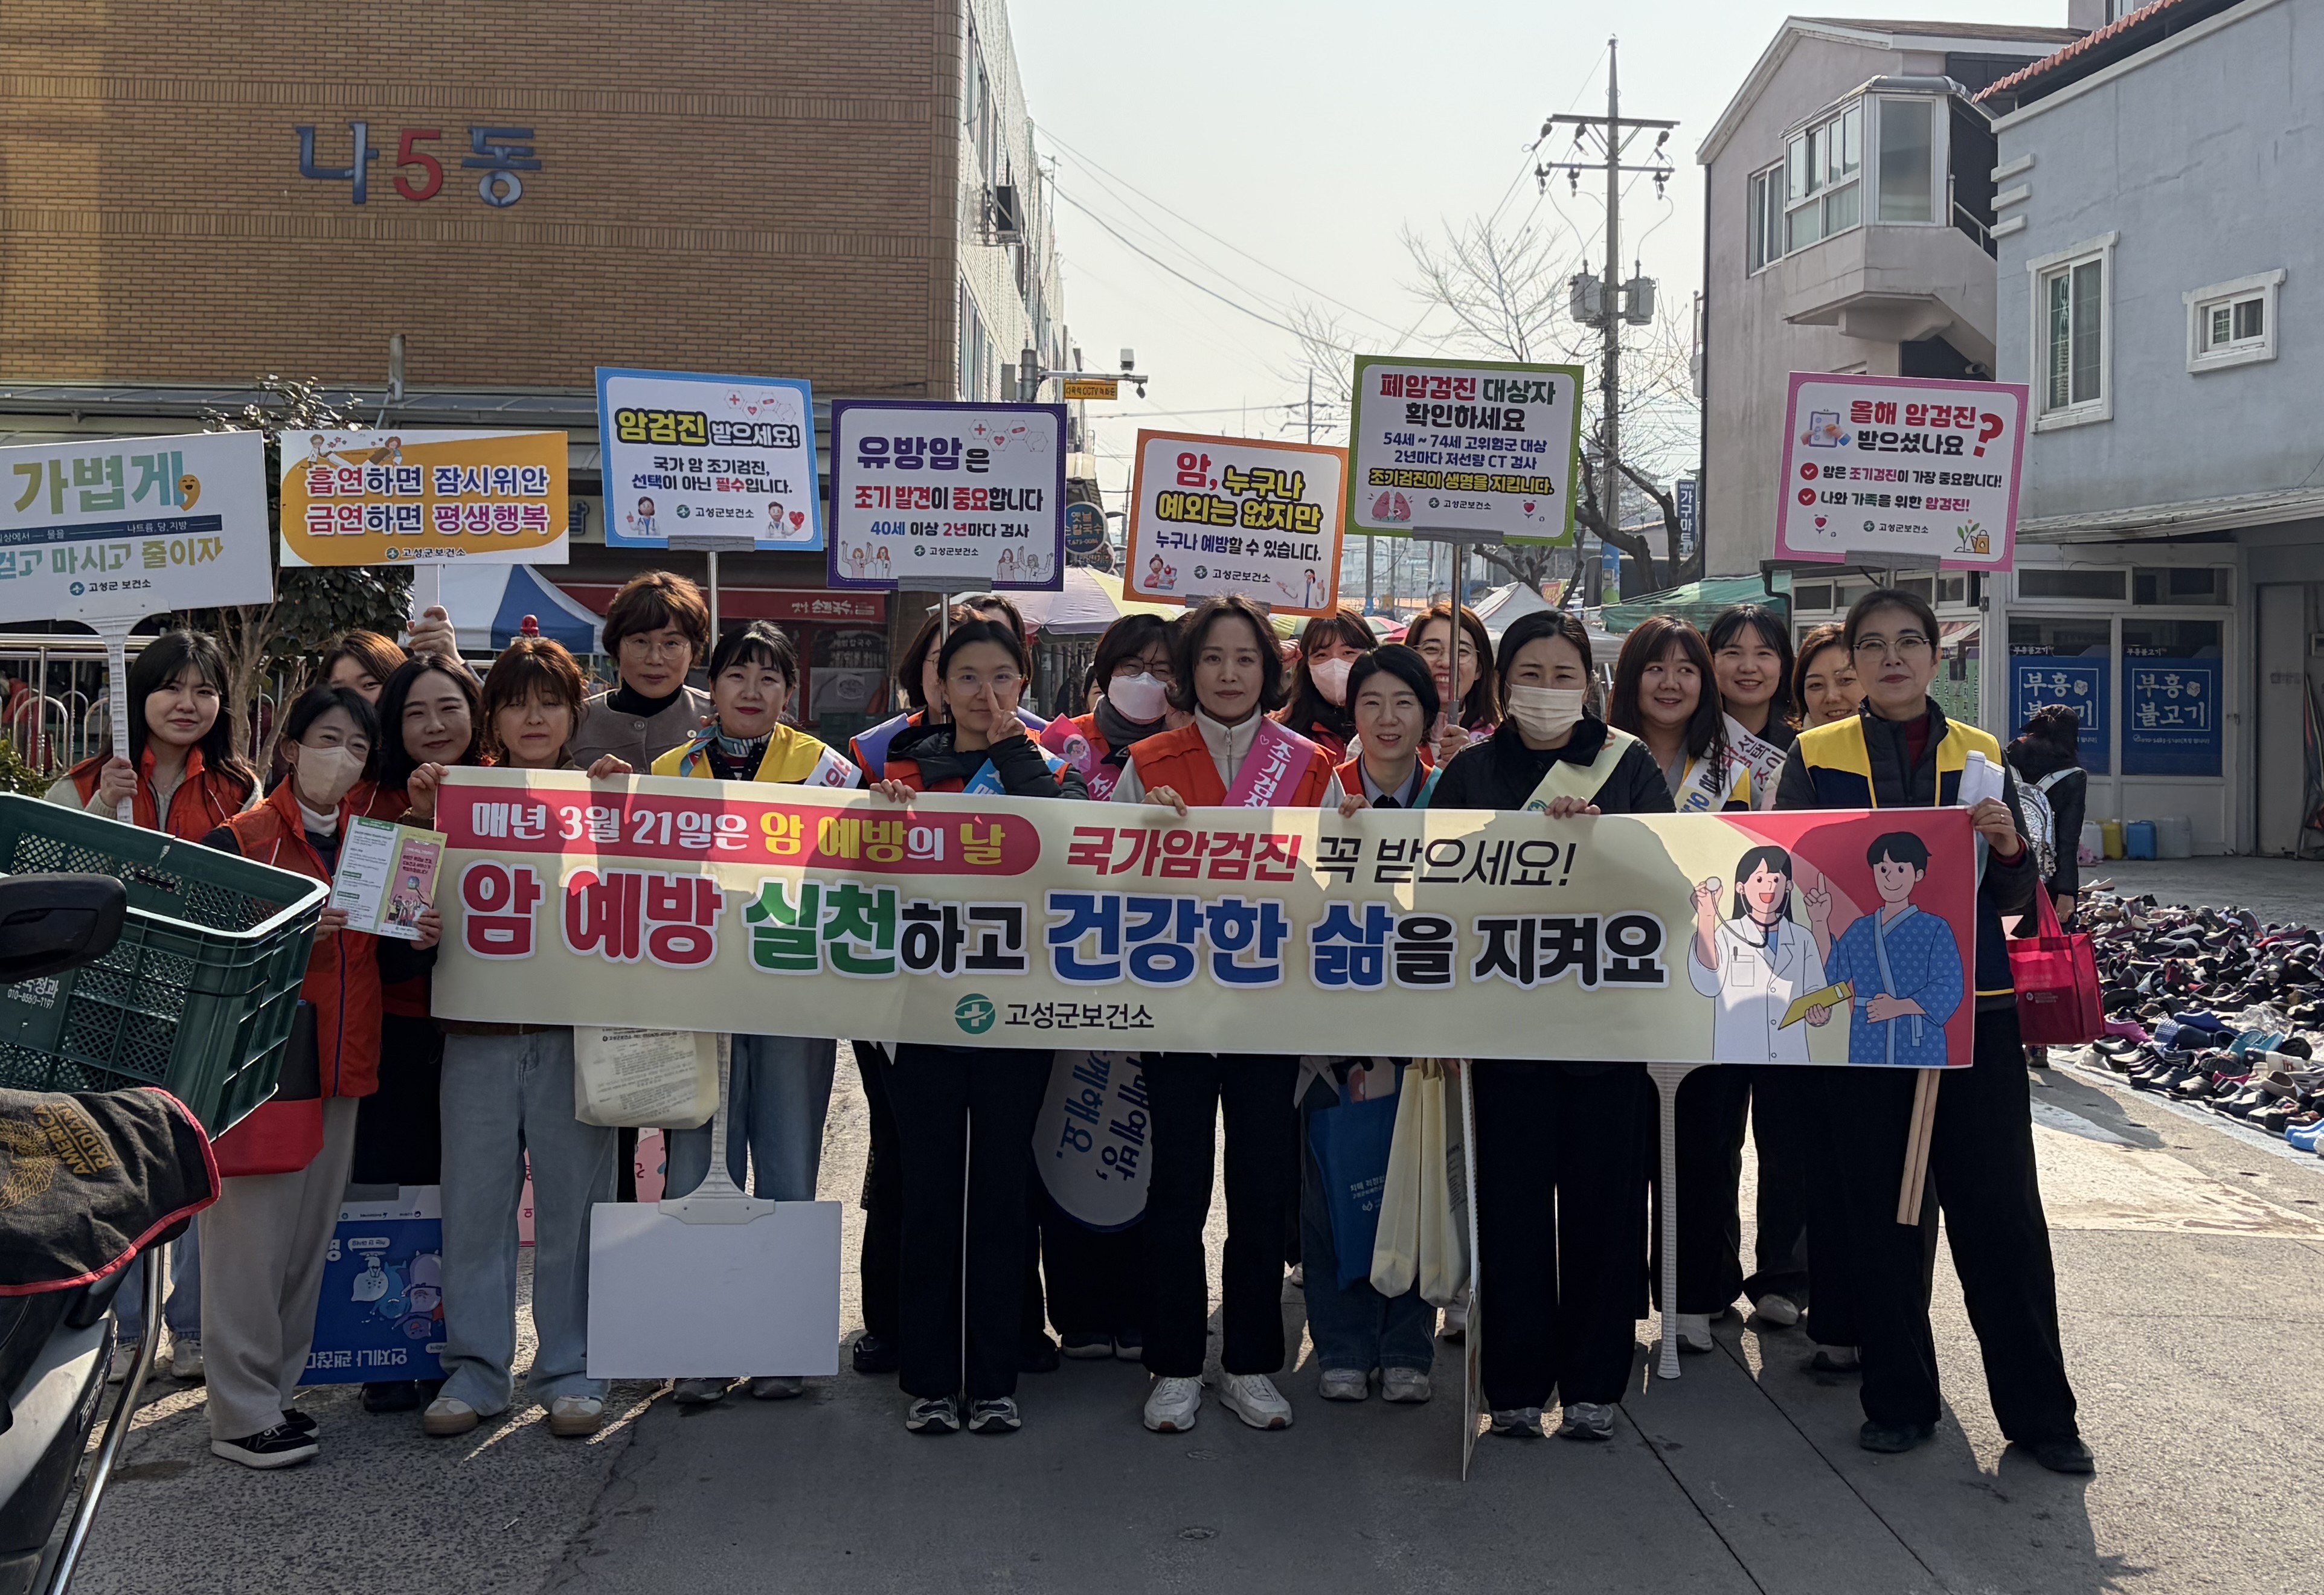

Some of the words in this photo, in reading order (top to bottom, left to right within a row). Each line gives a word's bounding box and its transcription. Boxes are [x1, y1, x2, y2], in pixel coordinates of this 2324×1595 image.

[1380, 373, 1475, 401] 폐암검진
[1482, 379, 1556, 405] 대상자
[1405, 402, 1526, 432] 확인하세요
[1850, 400, 1897, 425] 올해
[1905, 403, 1977, 429] 암검진
[617, 409, 708, 445] 암검진
[711, 422, 800, 448] 받으세요!
[857, 436, 990, 473] 유방암은
[1383, 432, 1414, 447] 54세
[1430, 435, 1461, 449] 74세
[1465, 436, 1517, 452] 고위험군
[1521, 439, 1547, 453] 대상
[653, 456, 684, 472] 국가
[689, 458, 704, 473] 암
[707, 458, 771, 477] 조기검진,
[1394, 450, 1443, 465] 2년마다
[1445, 452, 1485, 467] 저선량
[1488, 455, 1507, 469] CT
[1510, 455, 1537, 470] 검사
[307, 466, 423, 495] 흡연하면
[434, 466, 548, 495] 잠시위안
[632, 473, 678, 490] 선택이
[682, 477, 712, 492] 아닌
[716, 477, 793, 494] 필수입니다.
[1176, 452, 1219, 491] 암,
[1224, 466, 1304, 500] 누구나
[1369, 467, 1442, 489] 조기검진이
[1445, 471, 1488, 492] 생명을
[1490, 473, 1555, 496] 지킵니다.
[1823, 466, 1846, 480] 암은
[1849, 466, 1909, 483] 조기검진이
[1913, 470, 1936, 484] 가장
[1939, 472, 2003, 488] 중요합니다!
[855, 485, 891, 509] 조기
[895, 486, 948, 510] 발견이
[953, 487, 1044, 512] 중요합니다
[1443, 499, 1492, 510] 고성군보건소
[1820, 492, 1848, 506] 나와
[1851, 492, 1892, 509] 가족을
[1895, 495, 1922, 510] 위한
[1925, 496, 1970, 512] 암검진!
[307, 504, 423, 534] 금연하면
[435, 504, 549, 534] 평생행복
[695, 507, 755, 519] 고성군보건소
[1158, 492, 1237, 525] 예외는
[1242, 500, 1323, 533] 없지만
[870, 521, 905, 536] 40세
[910, 522, 939, 537] 이상
[943, 522, 997, 538] 2년마다
[1000, 523, 1030, 539] 검사
[1878, 523, 1929, 534] 고성군보건소
[52, 543, 132, 574] 마시고
[141, 536, 223, 570] 줄이자
[401, 548, 466, 558] 고성군보건소
[929, 547, 980, 557] 고성군보건소
[1156, 530, 1197, 551] 누구나
[1201, 534, 1242, 554] 예방할
[1245, 538, 1259, 556] 수
[1263, 540, 1322, 562] 있습니다.
[121, 579, 152, 591] 보건소
[1212, 568, 1271, 583] 고성군보건소
[2024, 672, 2072, 698] 부흥
[2136, 673, 2184, 699] 부흥
[2024, 700, 2093, 727] 불기
[2136, 701, 2205, 728] 불고기
[472, 802, 546, 839] 매년
[558, 805, 620, 844] 3월
[632, 810, 750, 850] 21일은
[760, 811, 805, 855] 암
[817, 816, 944, 863] 예방의
[960, 823, 1006, 865] 날
[1067, 826, 1302, 882] 국가암검진
[1315, 836, 1362, 884] 꼭
[1373, 838, 1577, 887] 받으세요!
[462, 863, 542, 955] 암
[564, 870, 724, 965] 예방
[745, 881, 1026, 975] 실천하고
[1048, 893, 1289, 984] 건강한
[1311, 904, 1454, 986] 삶을
[1474, 914, 1665, 987] 지켜요
[1004, 1001, 1155, 1030] 고성군보건소
[356, 1347, 408, 1367] 언제나
